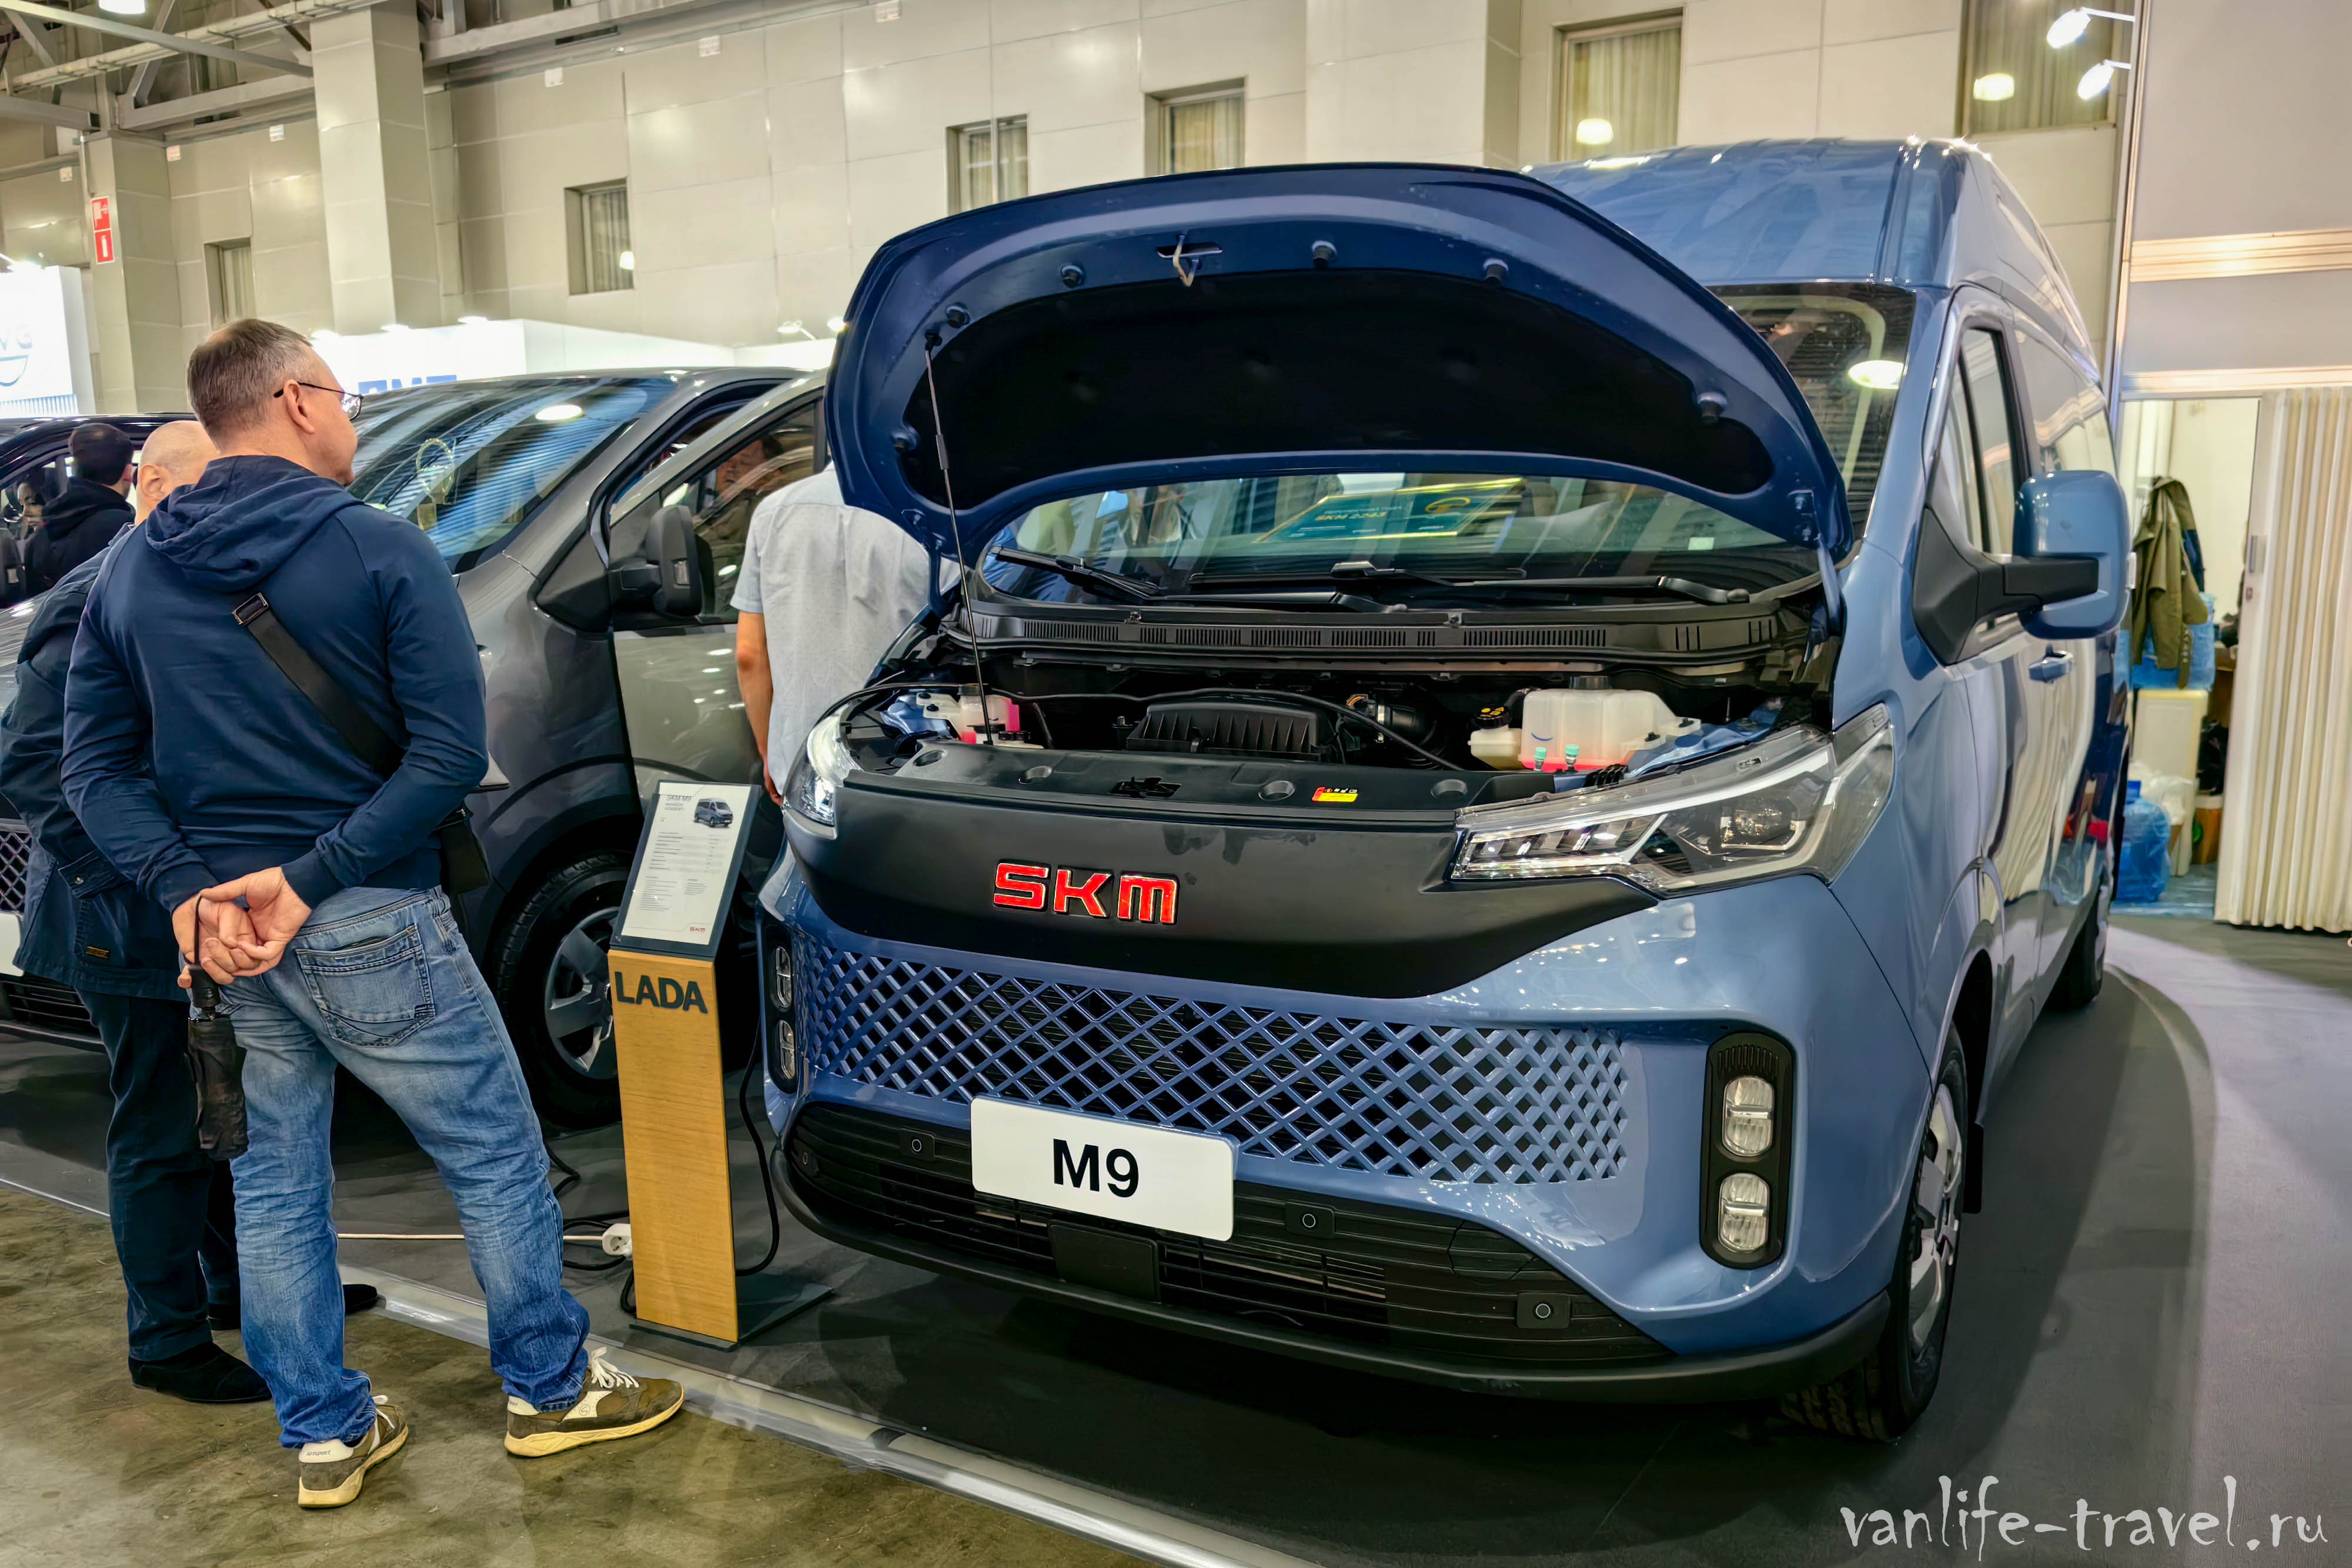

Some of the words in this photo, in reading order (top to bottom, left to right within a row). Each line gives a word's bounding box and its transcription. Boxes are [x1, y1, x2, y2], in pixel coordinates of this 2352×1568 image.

[993, 861, 1179, 924] SKM
[614, 971, 709, 1014] LADA
[1053, 1138, 1140, 1198] M9
